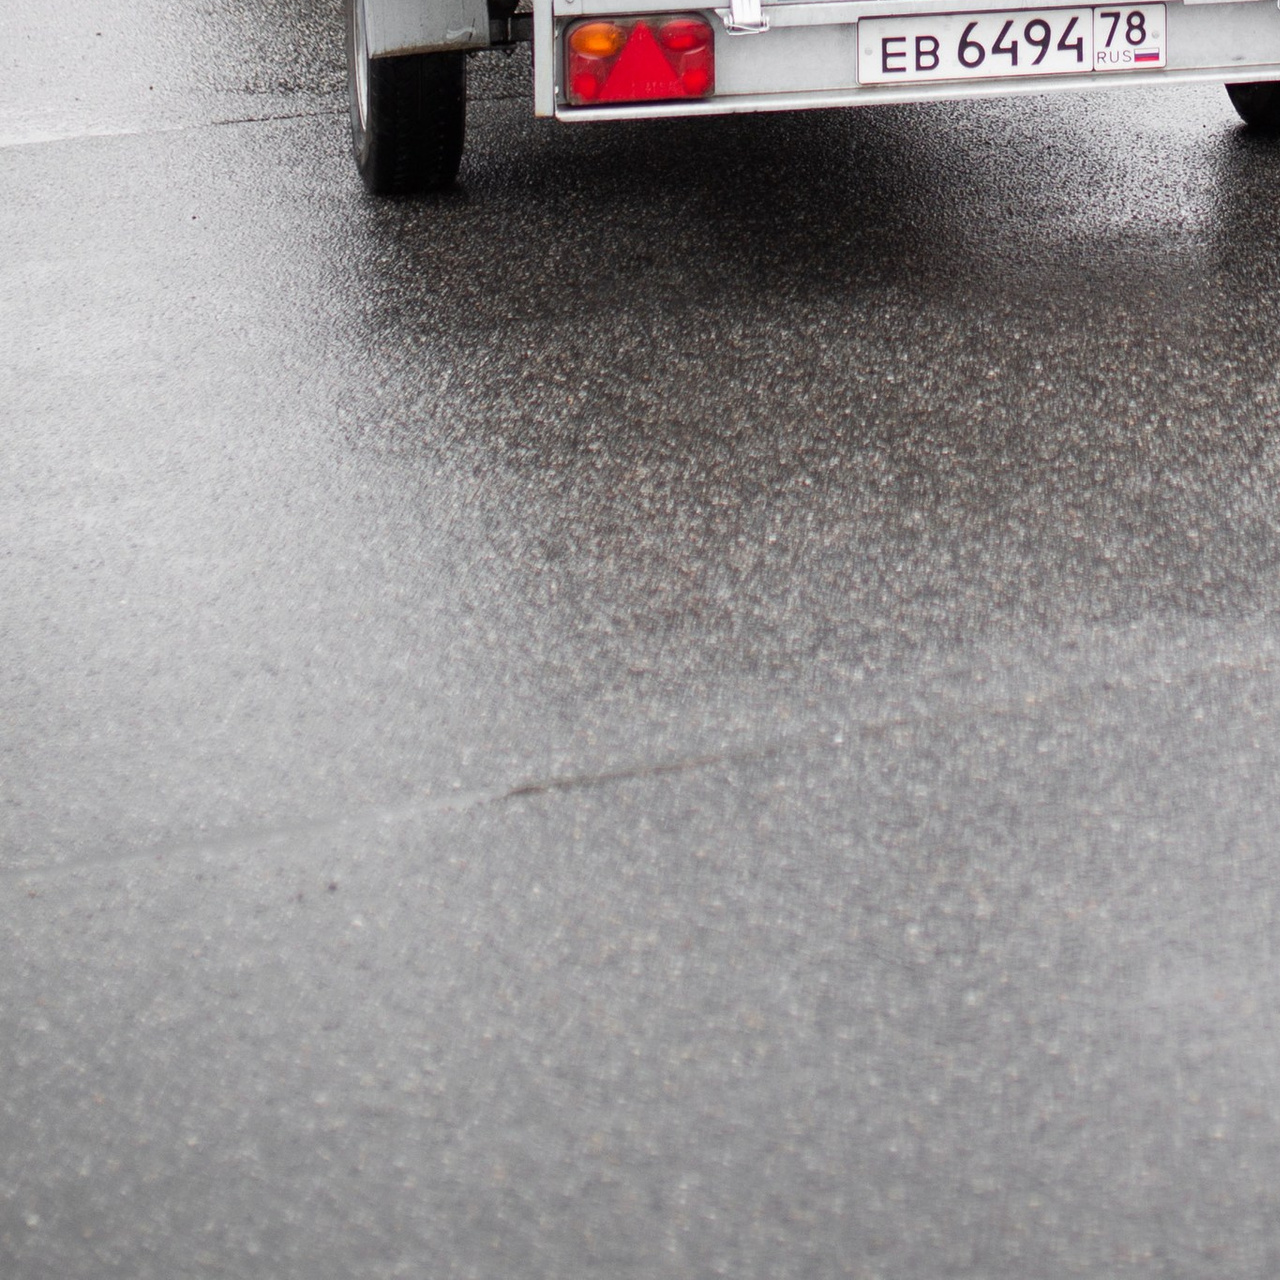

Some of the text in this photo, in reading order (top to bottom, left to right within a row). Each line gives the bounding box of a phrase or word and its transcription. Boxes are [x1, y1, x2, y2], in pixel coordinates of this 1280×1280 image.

[881, 10, 1146, 73] ЕВ 6494 78
[1096, 49, 1132, 65] RUS
